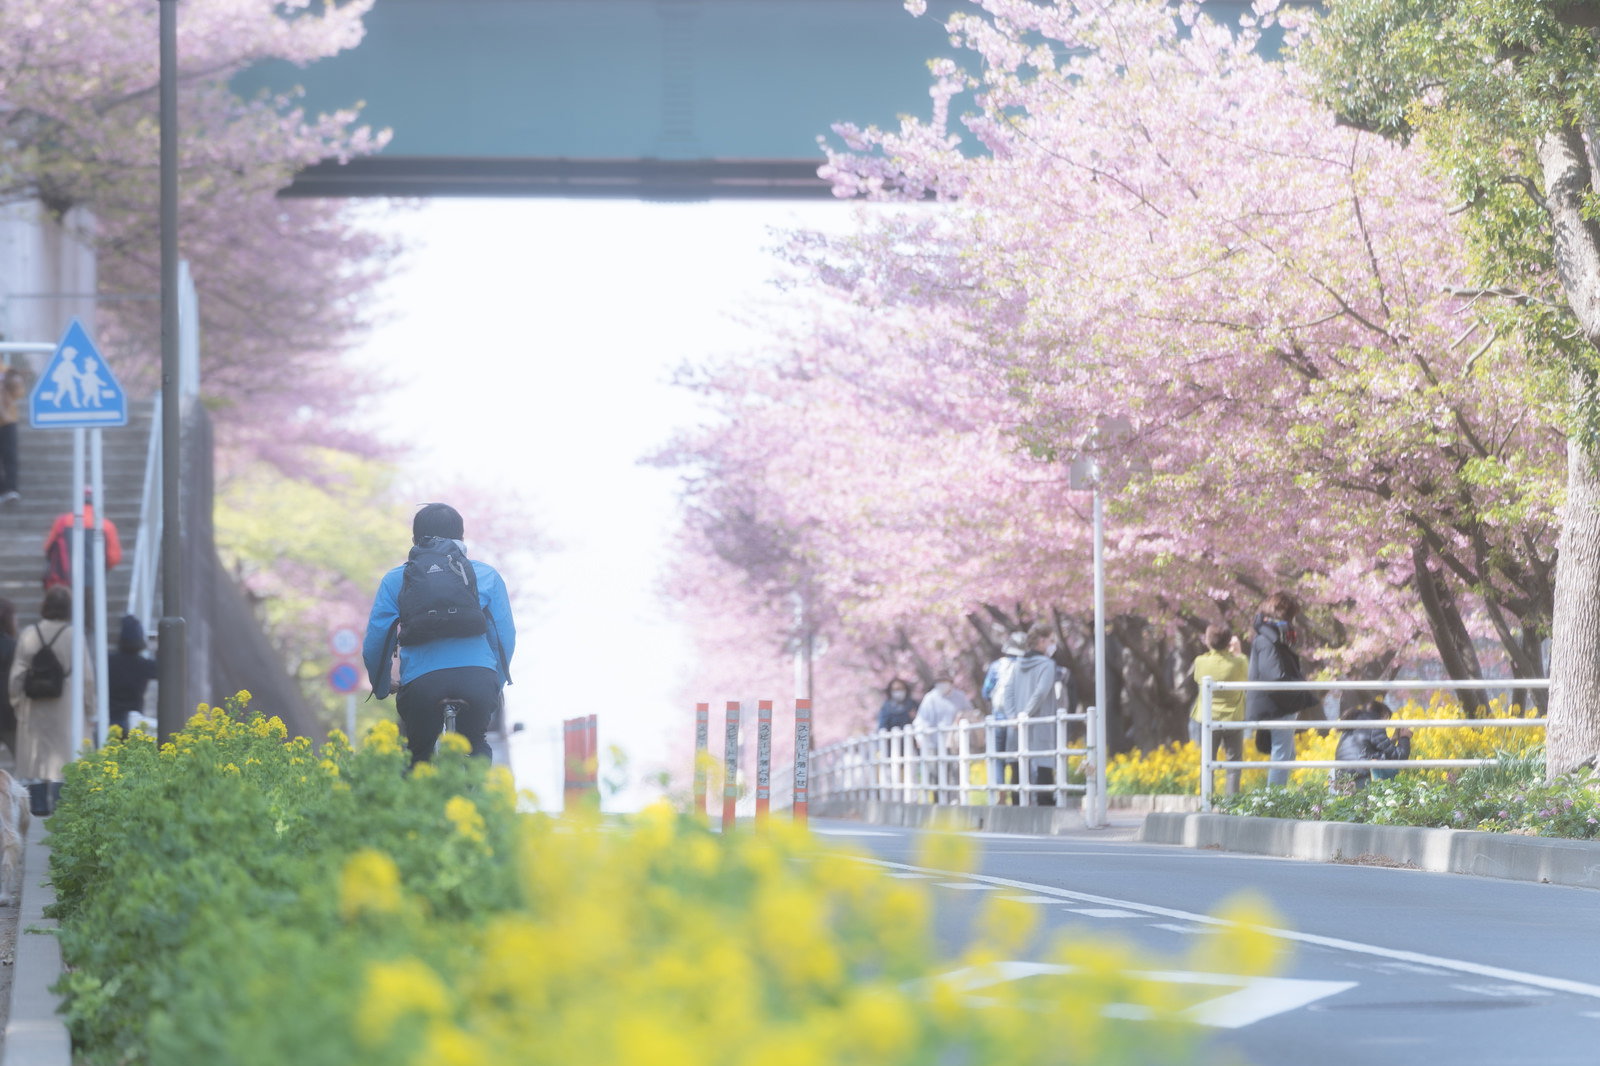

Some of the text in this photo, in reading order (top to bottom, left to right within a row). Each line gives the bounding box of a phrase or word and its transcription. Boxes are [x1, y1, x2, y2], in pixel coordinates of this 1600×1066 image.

[759, 724, 770, 785] スピード落とせ
[796, 725, 808, 787] スピード落とせ
